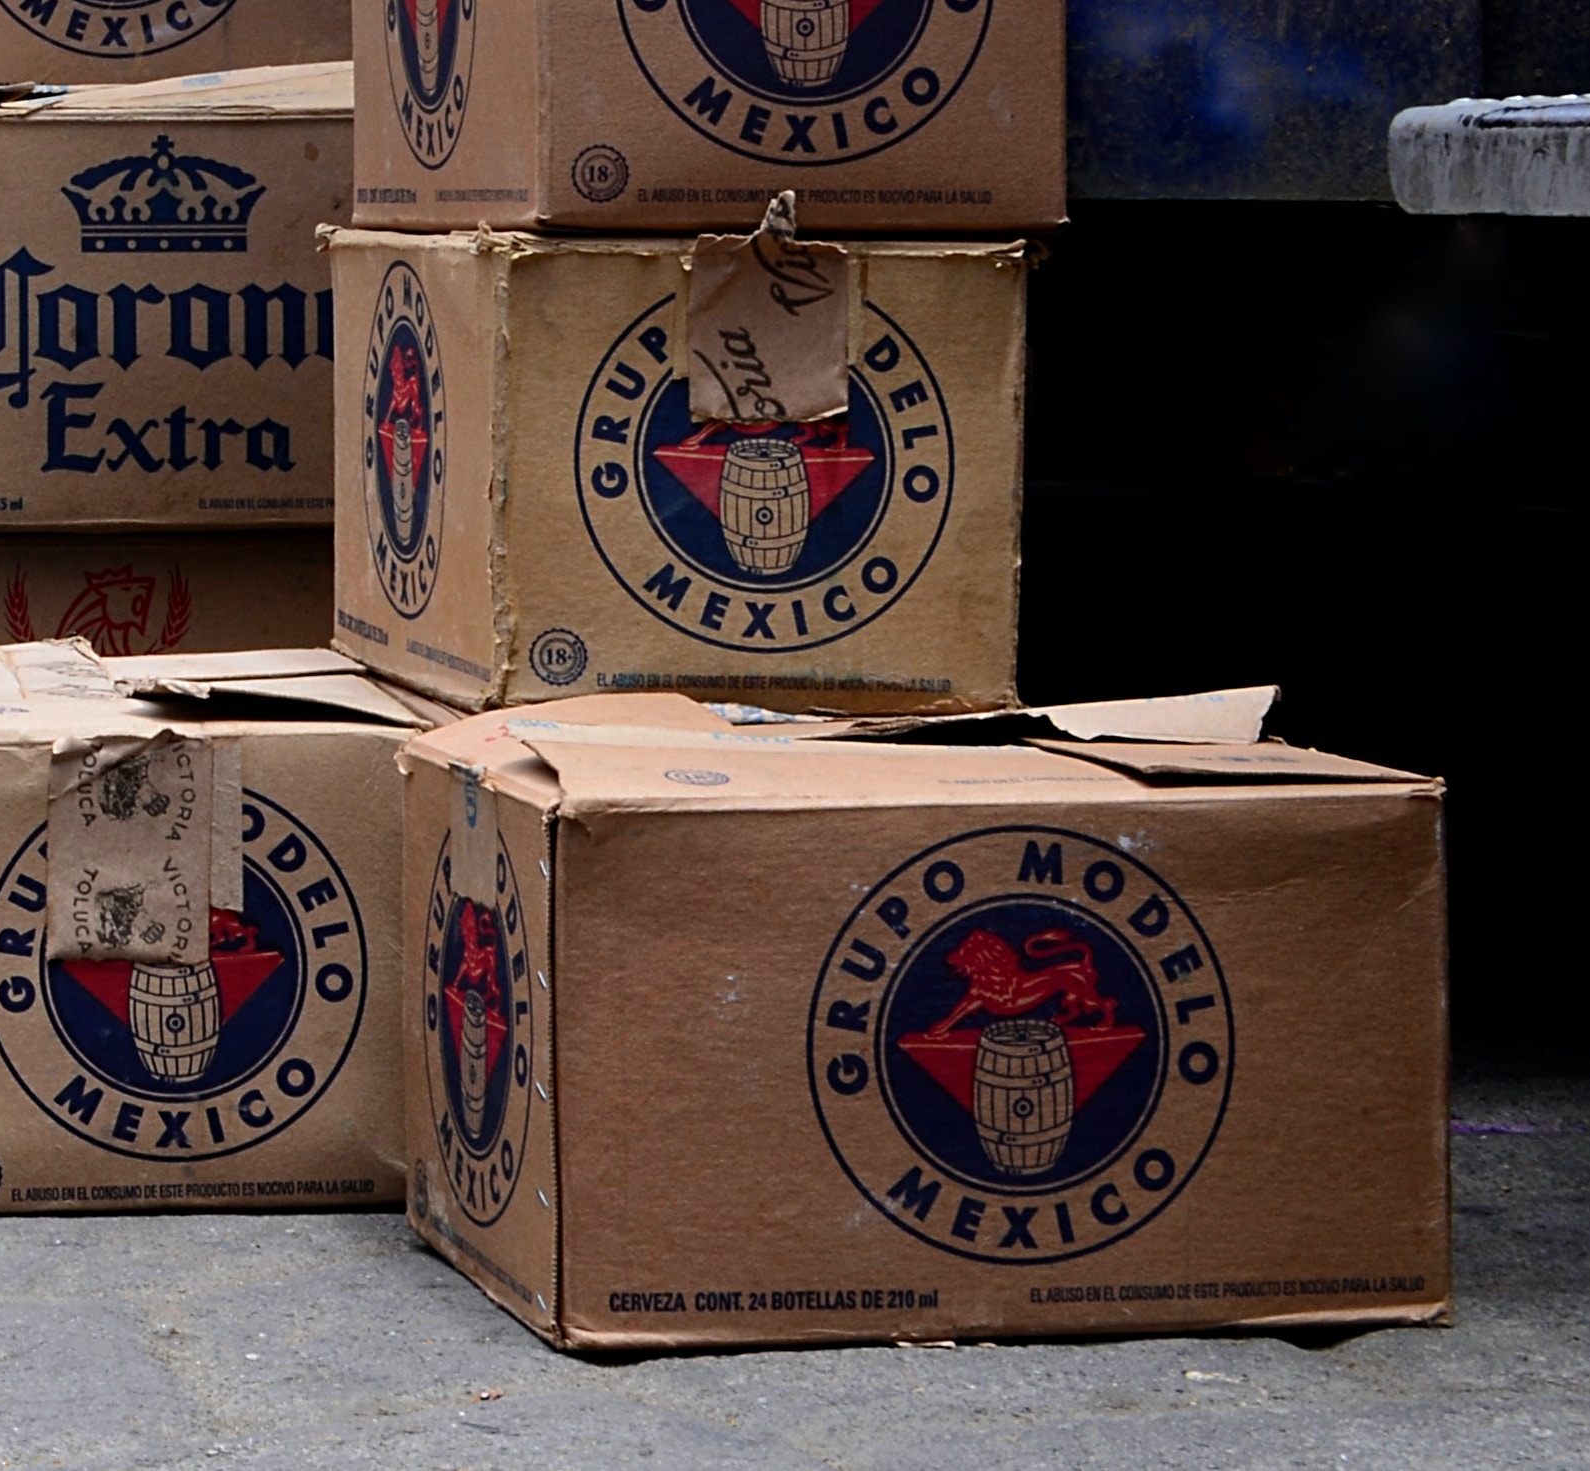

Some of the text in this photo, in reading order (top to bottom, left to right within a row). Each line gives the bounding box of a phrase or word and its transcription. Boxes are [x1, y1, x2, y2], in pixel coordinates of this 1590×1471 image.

[400, 72, 464, 160] MEXICO
[682, 65, 941, 155] MEXICO
[637, 188, 649, 203] EL
[651, 188, 685, 203] ABUSO
[686, 188, 699, 203] EN
[701, 188, 713, 203] EL
[715, 188, 765, 203] CONSUMO
[808, 189, 861, 204] PRODUCTO
[863, 189, 877, 204] ES
[877, 189, 916, 204] NOCIVO
[917, 190, 946, 204] PARA
[946, 190, 958, 204] LA
[959, 190, 993, 205] SALUD
[363, 271, 443, 487] GRUPO MODELO
[592, 325, 941, 505] GRUP DELO
[41, 381, 297, 474] Extra
[373, 530, 437, 610] MEXICO
[643, 555, 899, 640] MEXICO
[596, 672, 609, 688] EL
[727, 675, 740, 690] DE
[741, 675, 767, 690] ESTE
[822, 676, 835, 692] ES
[76, 742, 104, 828] TOLUCA
[165, 744, 197, 843] ICTORIA
[72, 868, 99, 955] TOLUCA
[163, 855, 193, 965] VICTORI
[241, 802, 355, 1004] ODELO
[426, 849, 529, 1090] GRUP ODELO
[827, 839, 1219, 1098] GRUPO MODELO
[54, 1055, 317, 1150] MEXICO
[11, 1179, 375, 1203] EL ABUSO EN EL CONSUMO DE ESTE PRODUCTO ES NOCIVO PARA LA SALUD
[438, 1108, 514, 1214] MEXICO
[885, 1145, 1176, 1252] MEXICO
[609, 1289, 939, 1312] CERVEZA CONT. 24 BOTELLAS DE 210 ml
[1029, 1287, 1044, 1303] EL
[1046, 1286, 1084, 1303] ABUSO
[1085, 1285, 1101, 1301] EN
[1102, 1285, 1117, 1301] EL
[1119, 1283, 1175, 1300] CONSUMO
[1177, 1283, 1192, 1299] DE
[1193, 1282, 1220, 1298] ESTE
[1222, 1280, 1282, 1297] PRODUCTO
[1282, 1280, 1297, 1296] ES
[1341, 1278, 1371, 1294] PARA
[1372, 1277, 1387, 1293] LA
[1388, 1276, 1427, 1293] SALUD
